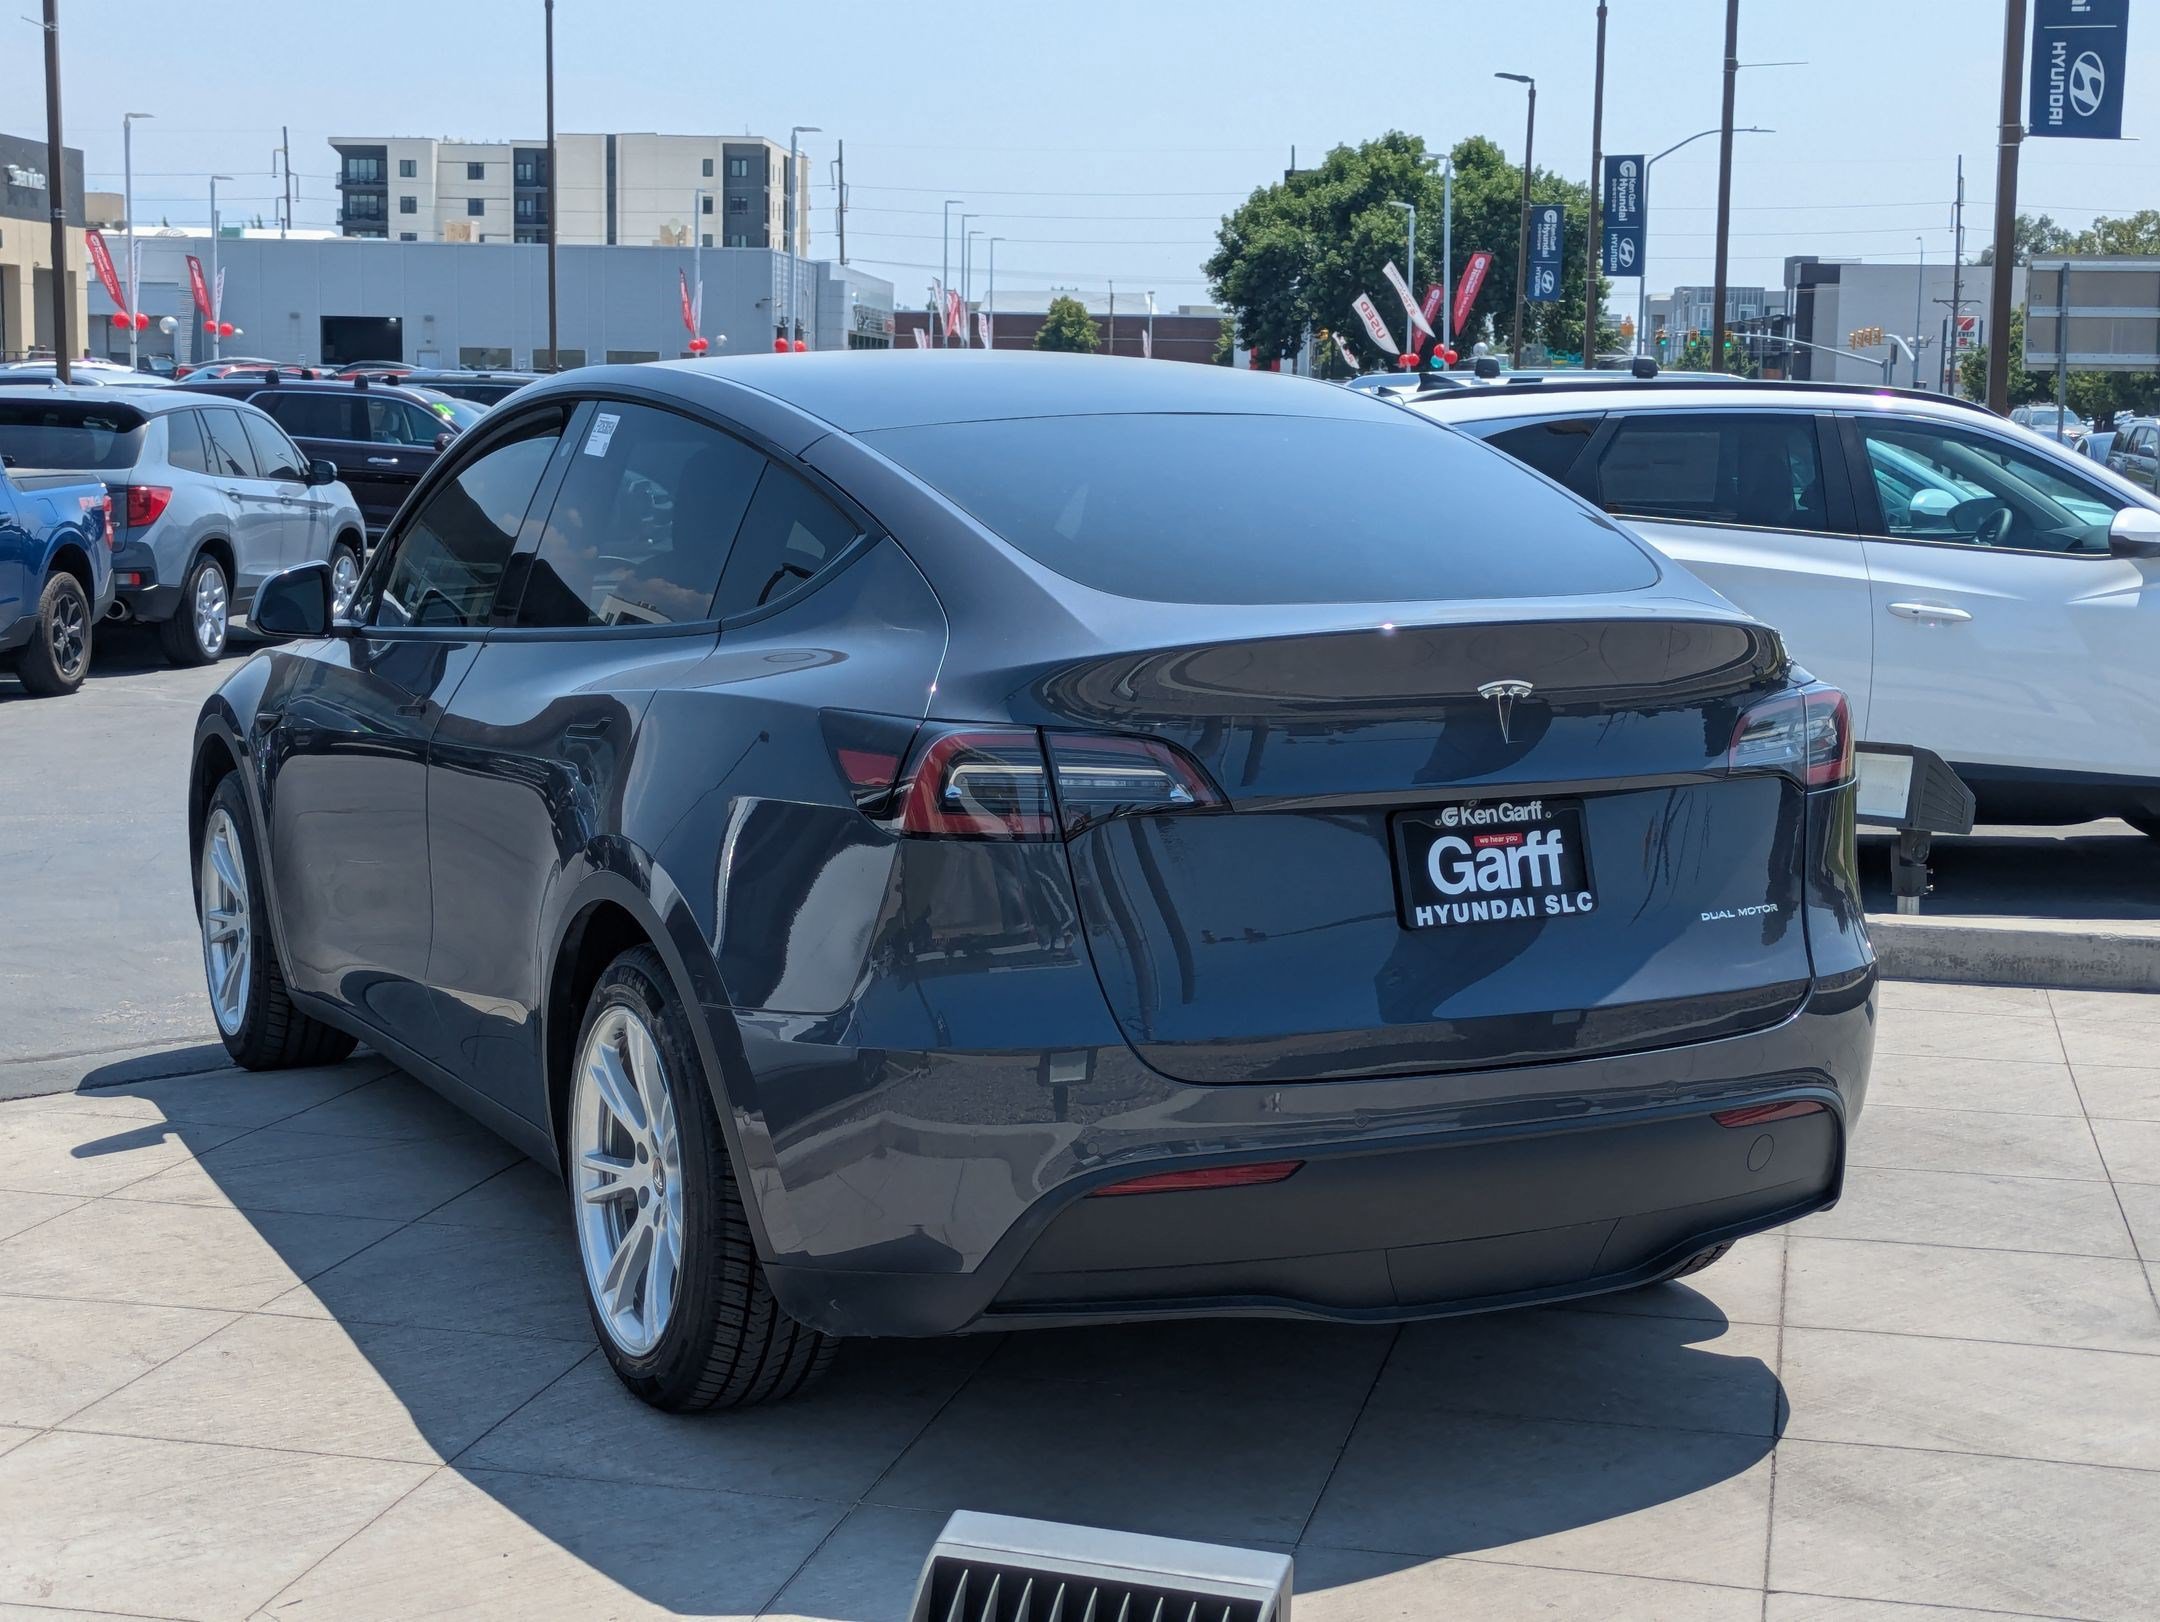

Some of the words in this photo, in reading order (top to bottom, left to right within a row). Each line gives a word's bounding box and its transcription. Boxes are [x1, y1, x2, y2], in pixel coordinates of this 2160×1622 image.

[2048, 41, 2067, 125] HYUNDAI
[1617, 178, 1628, 221] Hyundai
[1628, 178, 1636, 193] Ken
[1628, 193, 1636, 212] Garff
[1542, 223, 1551, 257] Hyundai
[1610, 233, 1618, 272] HYUNDAI
[1461, 805, 1497, 825] Ken
[1498, 800, 1543, 823] Garff
[1490, 835, 1504, 843] hear
[1505, 835, 1518, 844] you
[1427, 829, 1563, 895] Garff
[1415, 897, 1536, 926] HYUNDAI
[1545, 891, 1593, 915] SLC
[1701, 910, 1736, 921] DUAL
[1738, 903, 1779, 917] MOTOR
